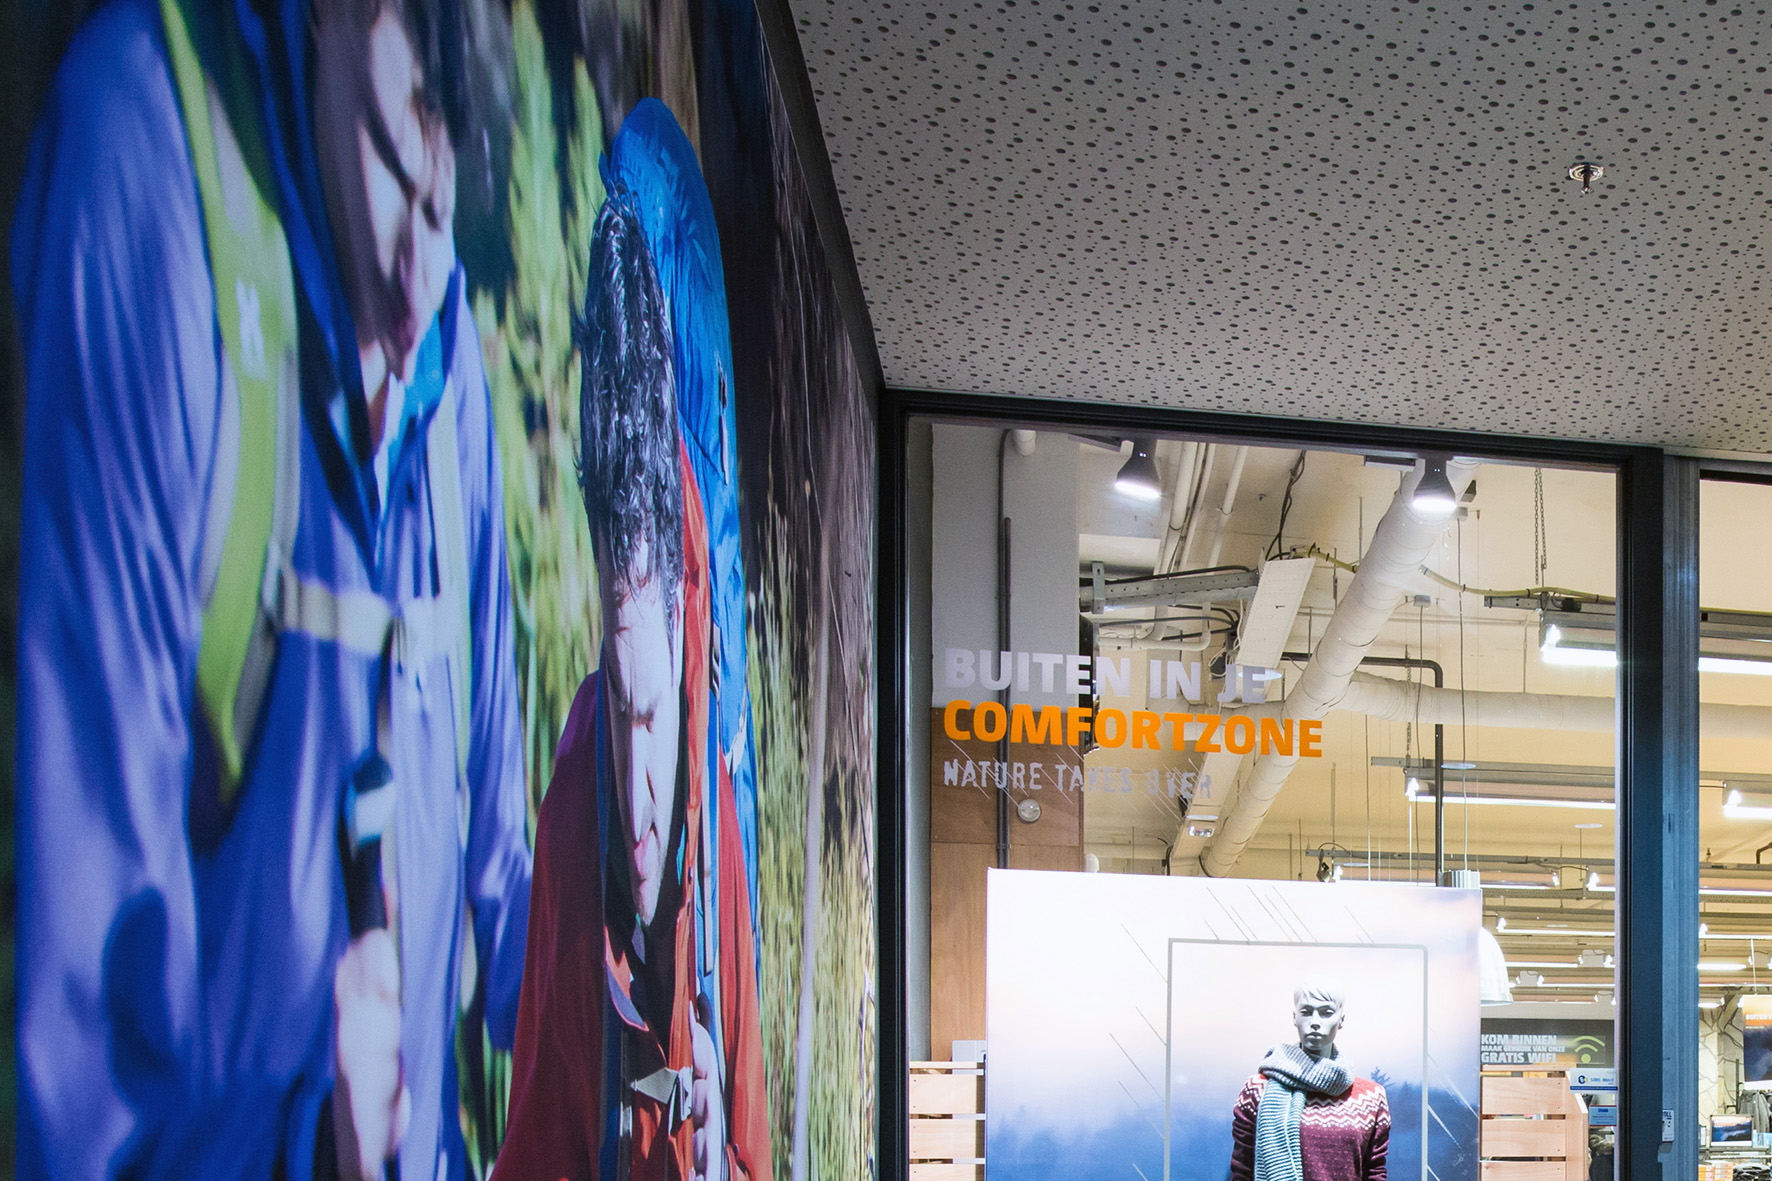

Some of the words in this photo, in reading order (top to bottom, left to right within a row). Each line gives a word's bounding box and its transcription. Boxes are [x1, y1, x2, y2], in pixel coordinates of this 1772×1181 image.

[943, 647, 1131, 698] BUITEN
[1149, 659, 1200, 700] IN
[1217, 664, 1266, 704] JE
[943, 700, 1323, 758] COMFORTZONE
[943, 759, 1043, 791] NATURE
[1055, 763, 1132, 794] TAKES
[1146, 768, 1212, 799] OVER
[1481, 1034, 1509, 1045] KOM
[1511, 1035, 1557, 1046] BINNEN
[1481, 1052, 1525, 1063] GRATIS
[1527, 1052, 1557, 1063] WIFI
